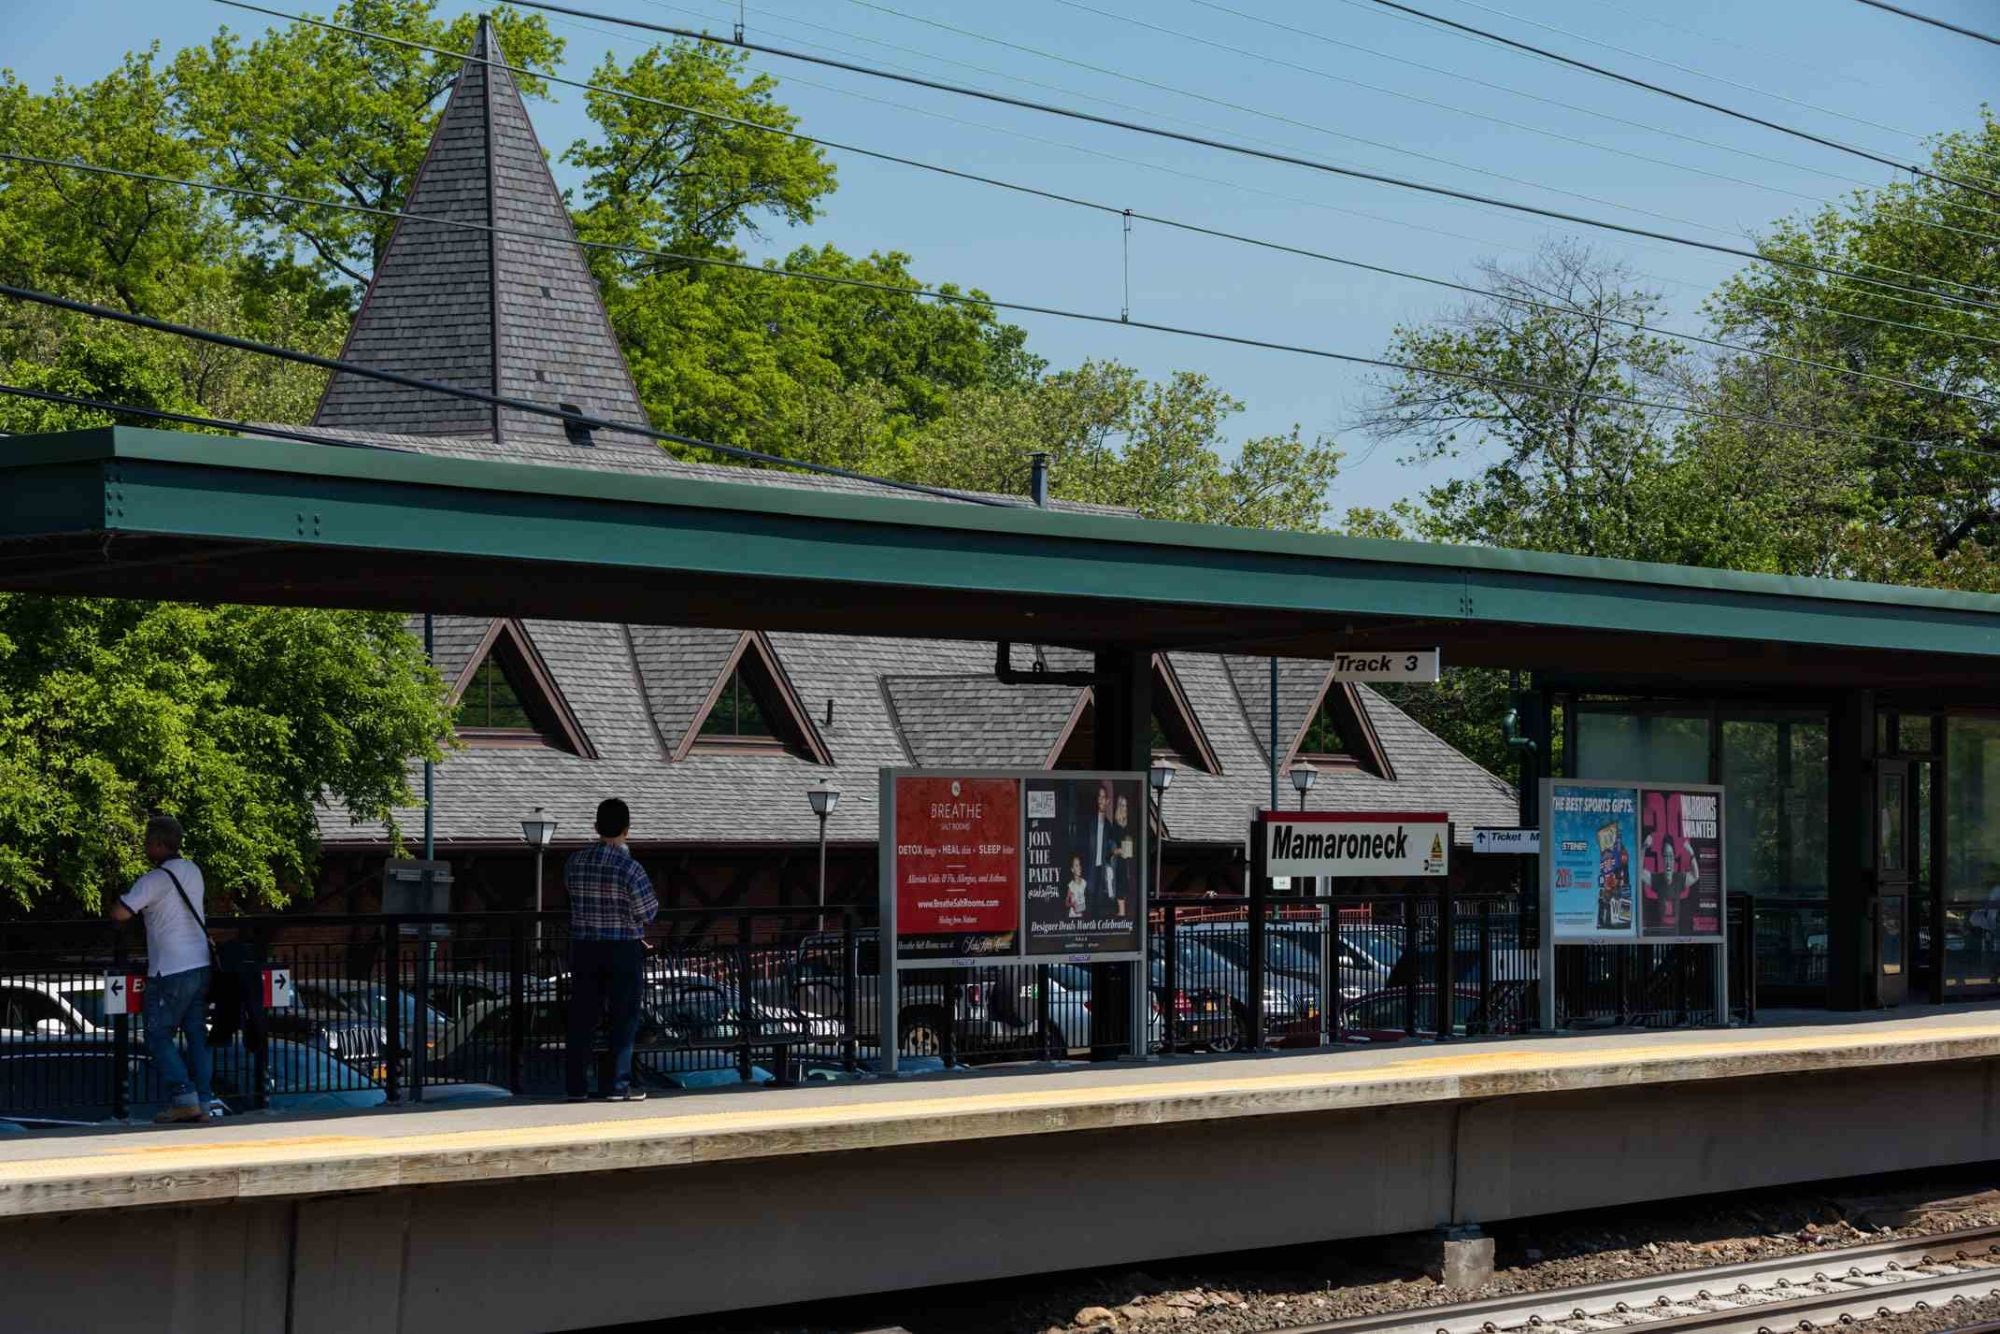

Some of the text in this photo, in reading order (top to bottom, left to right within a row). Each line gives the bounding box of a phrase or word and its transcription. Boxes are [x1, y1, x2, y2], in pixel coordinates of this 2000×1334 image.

[1337, 654, 1418, 671] Track 3
[930, 803, 982, 819] BREATHE
[1553, 796, 1565, 811] THE
[1565, 797, 1584, 812] BEST
[1584, 798, 1611, 812] SPORTS
[1680, 794, 1717, 820] WARRIORS
[1492, 832, 1522, 841] Ticket
[1682, 820, 1717, 839] WANTED
[1027, 831, 1052, 849] JOIN
[1271, 824, 1408, 860] Mamaroneck
[898, 844, 923, 856] DETOX
[942, 844, 960, 855] HEAL
[979, 844, 1001, 855] SLEEP
[1028, 849, 1051, 865] THE
[1028, 867, 1061, 883] PARTY
[1031, 918, 1134, 935] Designer Deals Worth Celebrating
